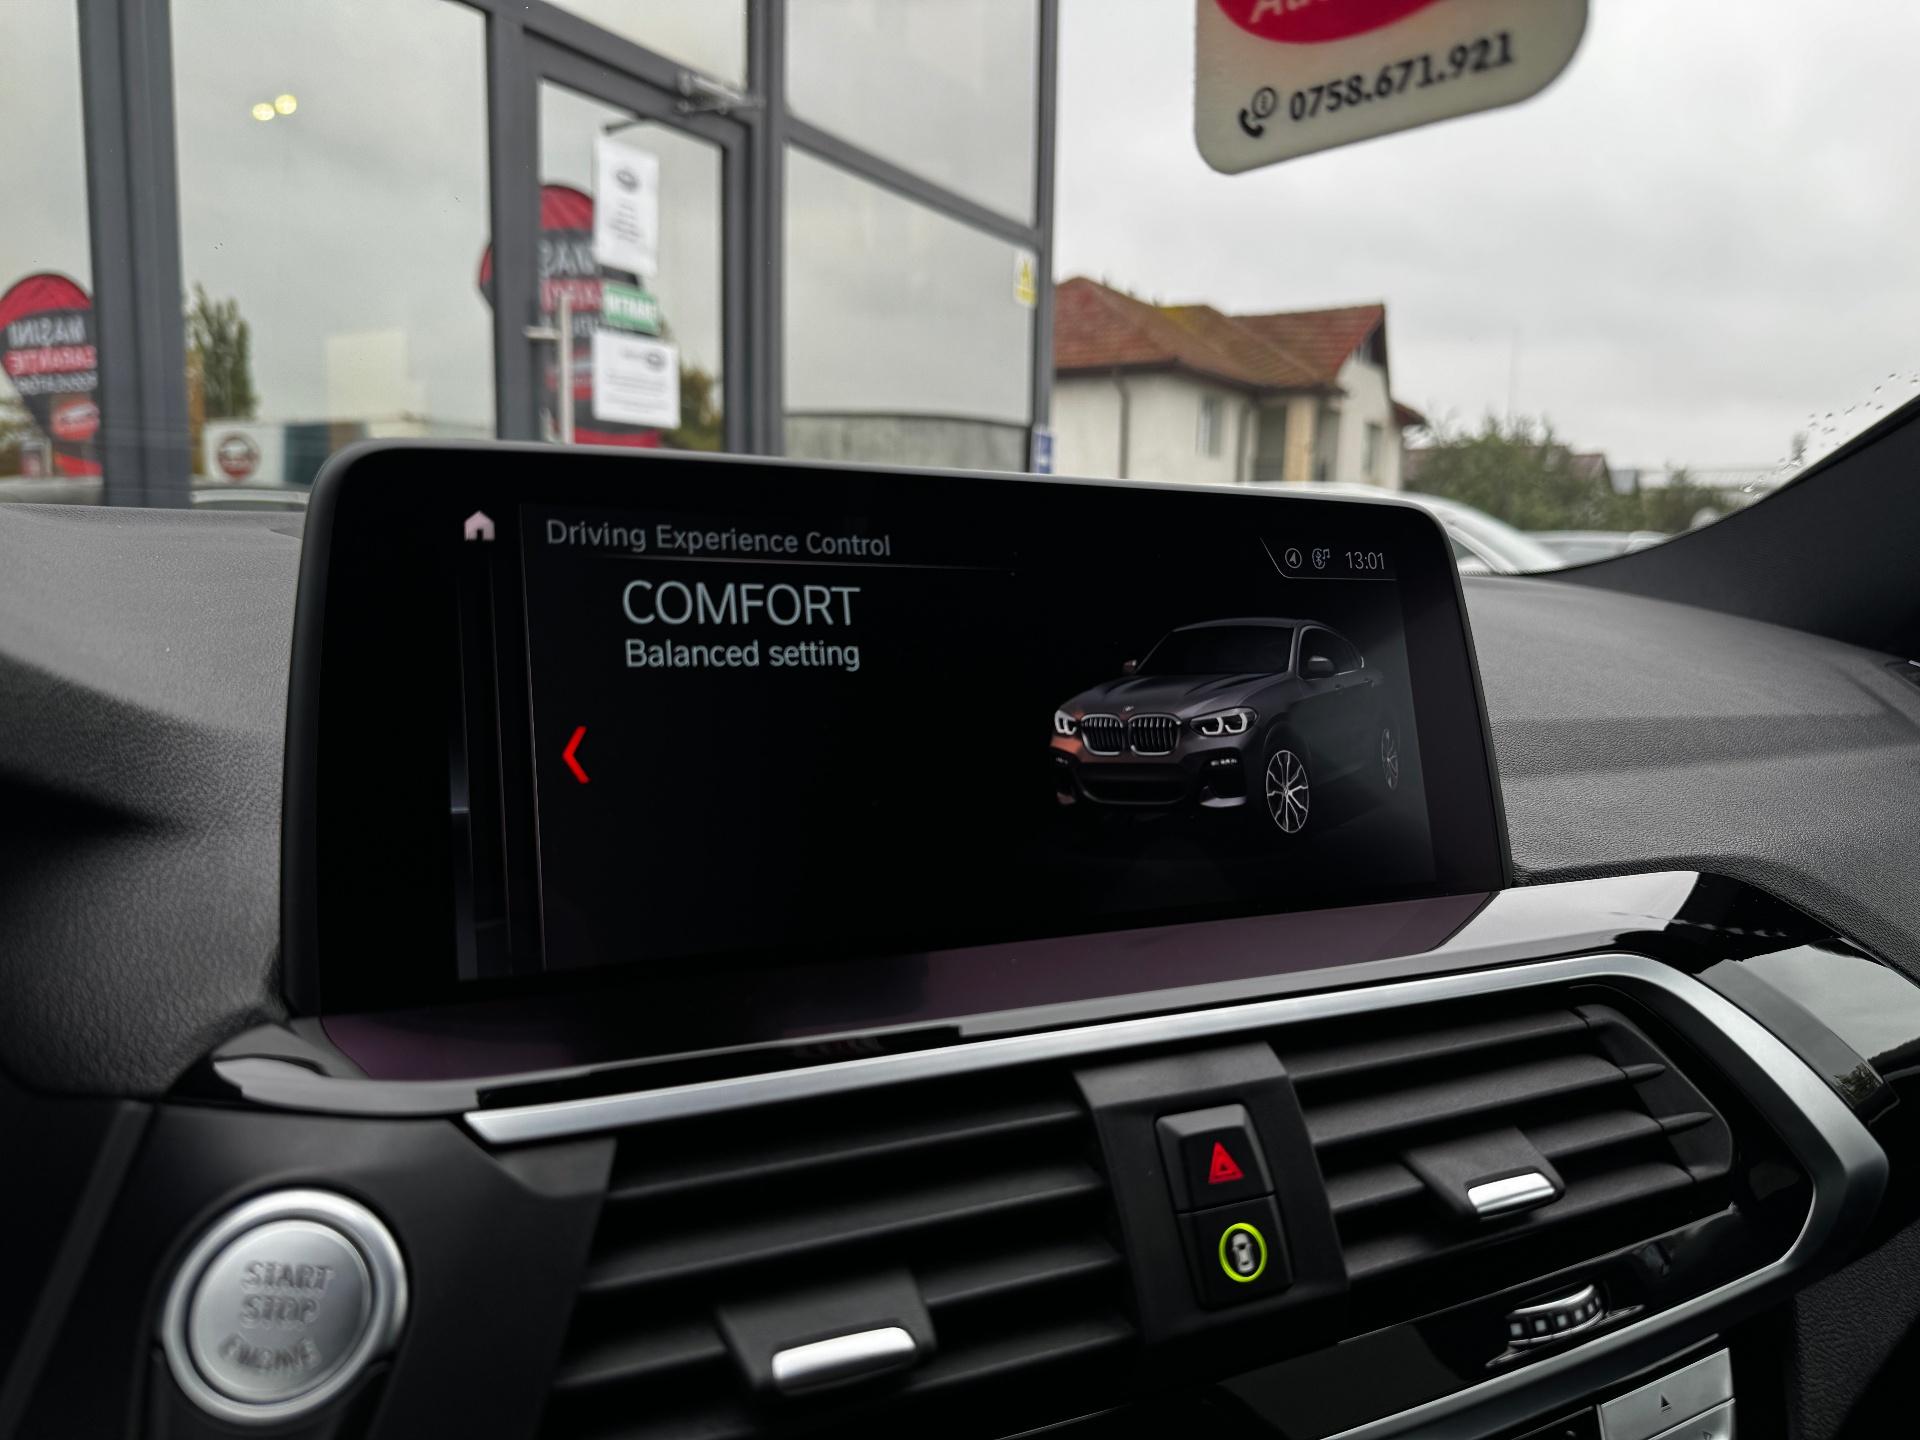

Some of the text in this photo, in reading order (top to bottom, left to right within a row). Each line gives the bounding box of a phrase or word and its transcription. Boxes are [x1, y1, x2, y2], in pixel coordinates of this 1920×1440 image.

[1289, 32, 1514, 121] 0758.671.921
[546, 519, 891, 556] Driving Experience Control
[1345, 551, 1386, 570] 13:01
[622, 579, 861, 626] COMFORT
[625, 638, 860, 672] Balanced setting
[244, 1260, 334, 1291] START
[241, 1295, 319, 1324] STOP
